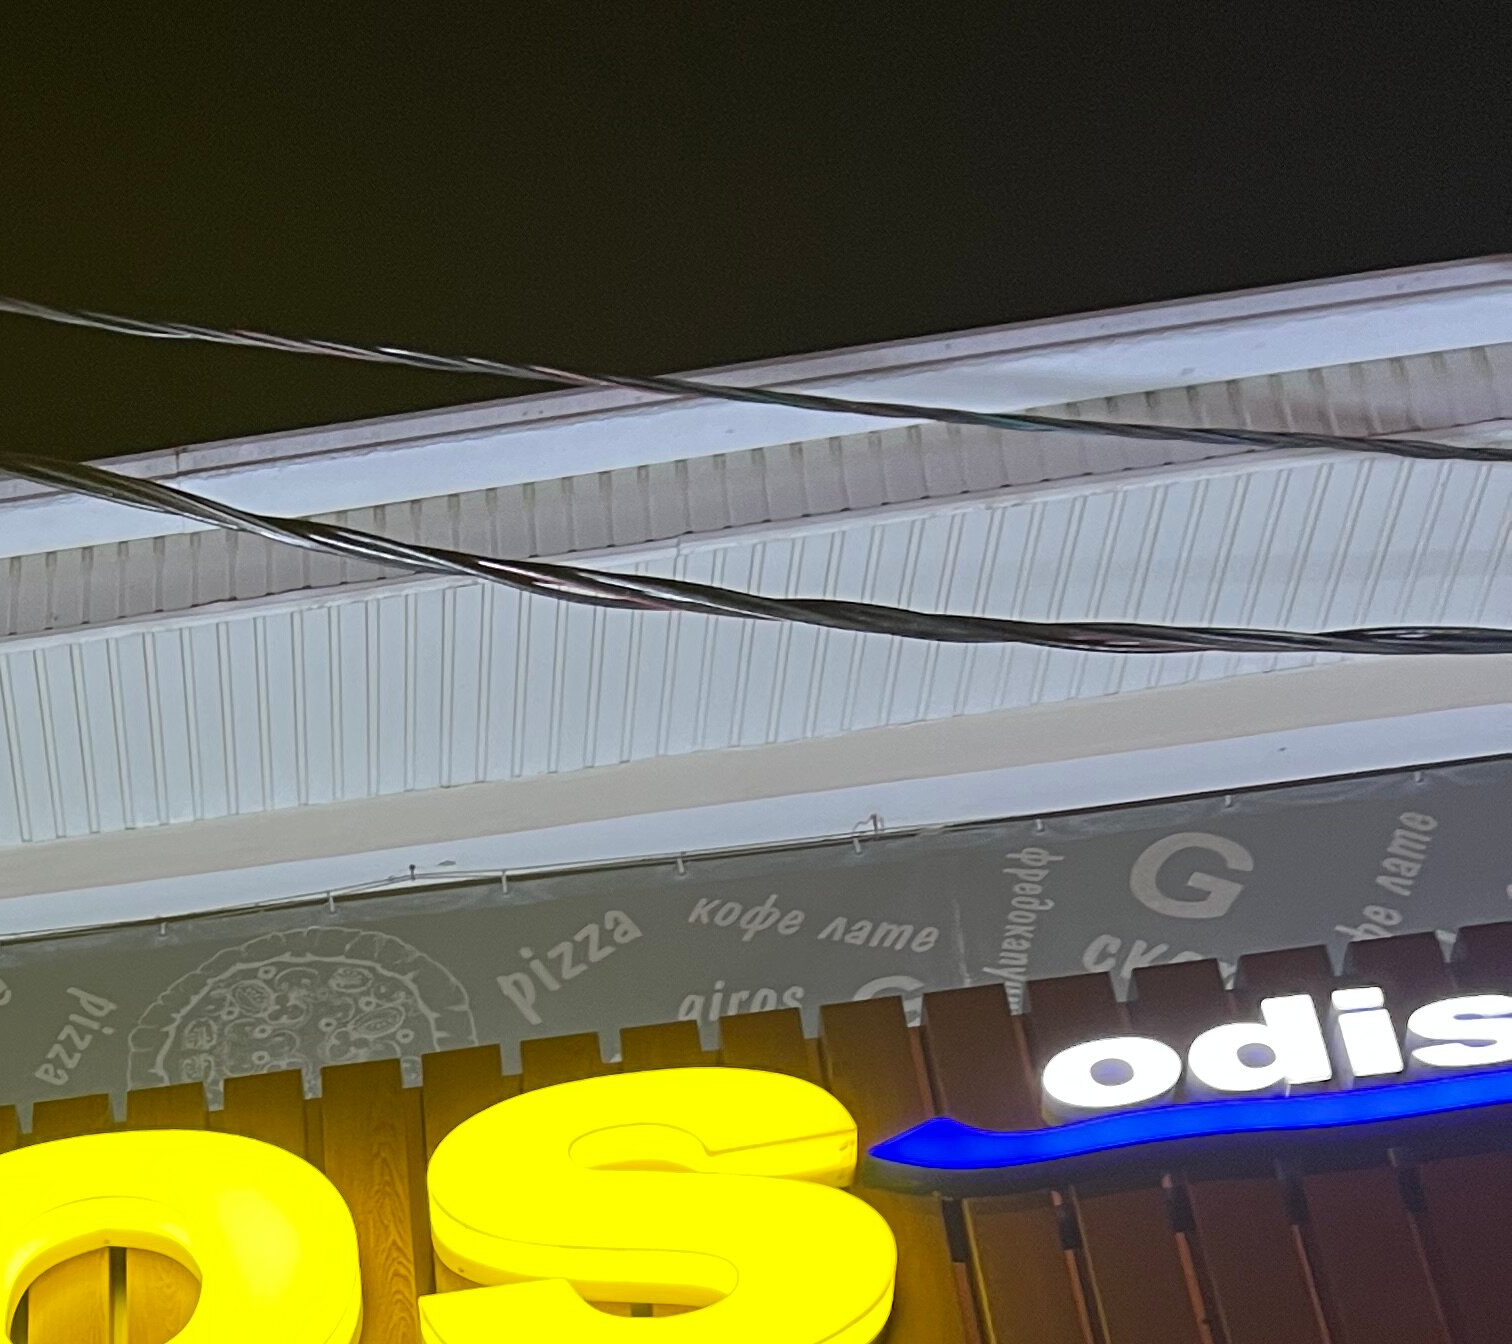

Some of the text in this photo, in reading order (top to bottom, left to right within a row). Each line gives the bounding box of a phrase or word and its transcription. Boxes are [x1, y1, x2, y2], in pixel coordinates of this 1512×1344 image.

[687, 893, 806, 942] кофе
[1129, 831, 1254, 919] G
[496, 909, 644, 1025] pizza
[34, 986, 118, 1086] pizza
